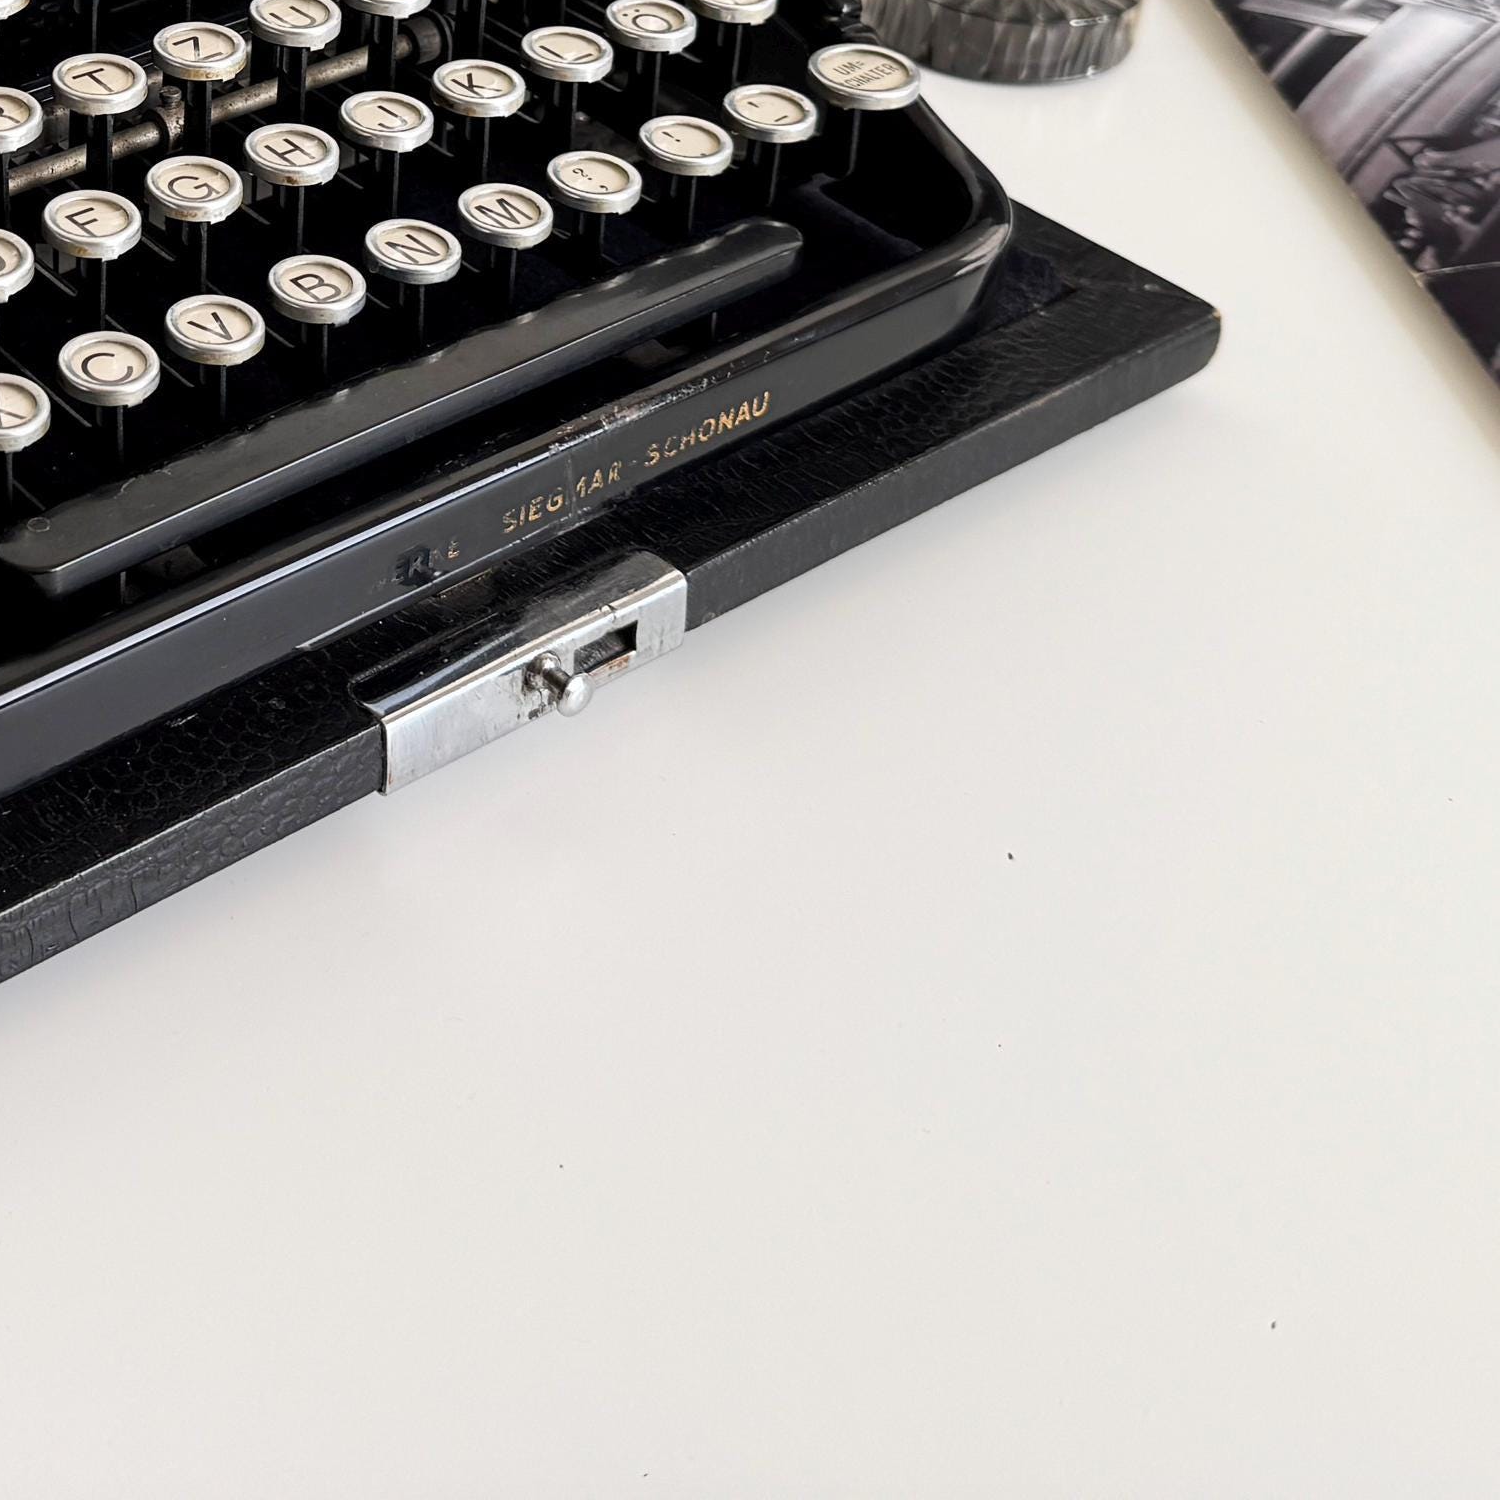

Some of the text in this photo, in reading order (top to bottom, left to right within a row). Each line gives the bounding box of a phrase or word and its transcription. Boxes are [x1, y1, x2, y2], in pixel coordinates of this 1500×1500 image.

[268, 5, 317, 29] U
[621, 8, 673, 34] Ö
[171, 35, 224, 62] Z
[538, 44, 593, 61] L
[71, 67, 115, 92] T
[450, 72, 503, 99] K
[842, 62, 900, 88] CHALTER
[376, 104, 409, 130] J
[263, 137, 316, 167] H
[167, 175, 221, 200] G
[64, 206, 99, 238] F
[473, 197, 534, 229] M
[384, 233, 441, 264] N
[288, 273, 342, 302] B
[186, 311, 234, 341] V
[80, 351, 134, 386] C
